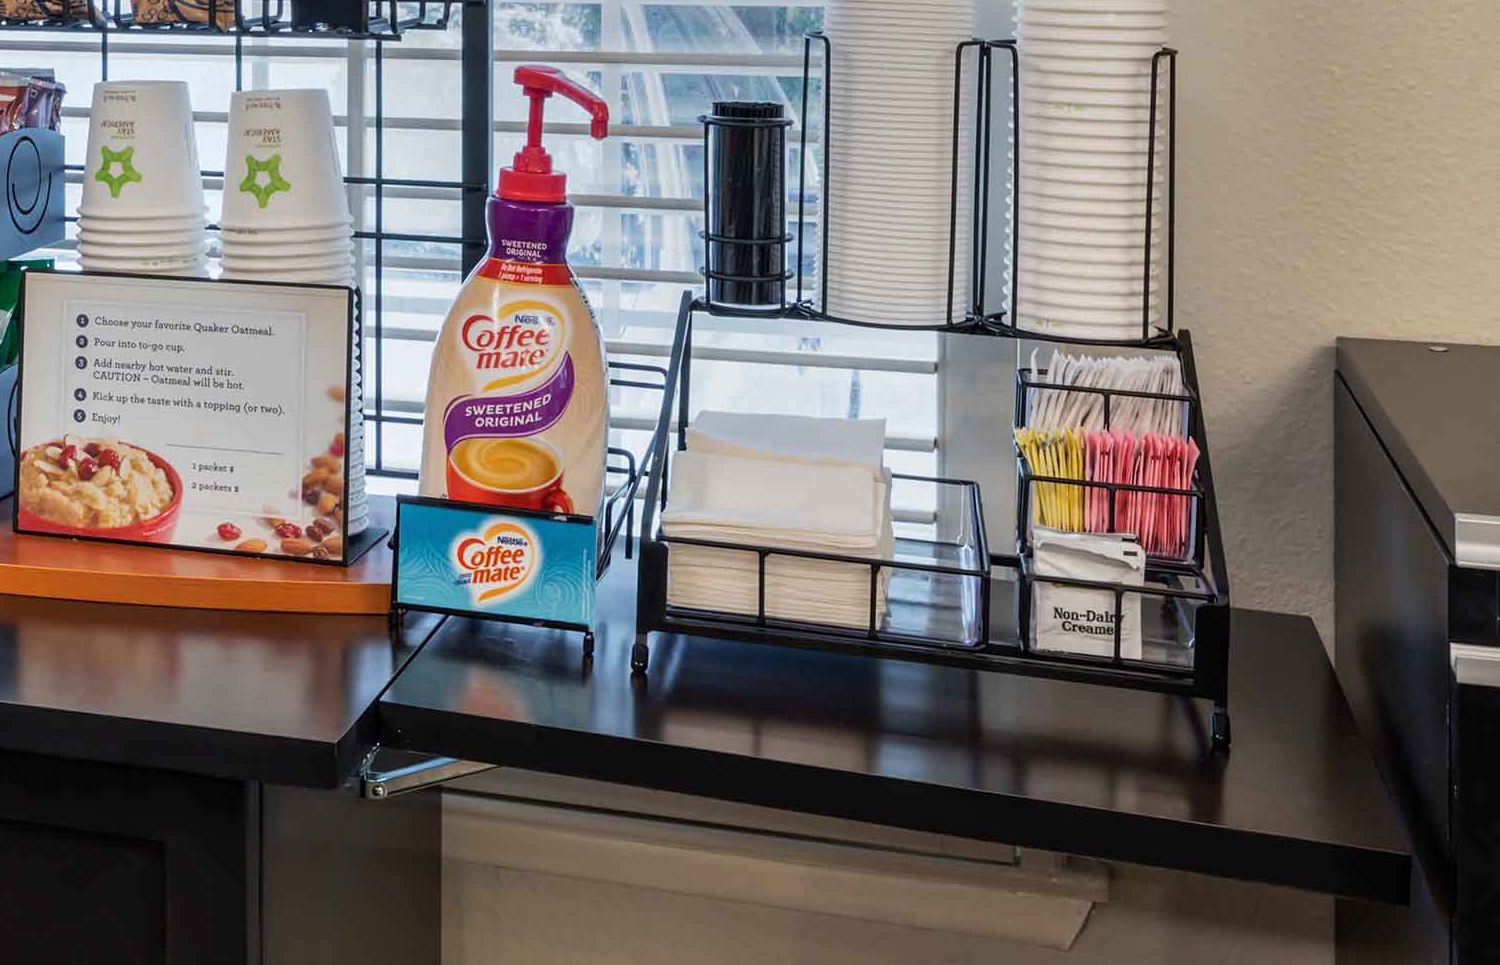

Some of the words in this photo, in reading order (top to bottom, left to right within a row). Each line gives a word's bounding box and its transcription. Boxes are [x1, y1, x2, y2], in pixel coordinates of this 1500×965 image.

[501, 239, 548, 251] SWEETENED
[506, 247, 541, 258] ORIGINAL
[94, 316, 129, 327] Choose
[131, 320, 152, 330] your
[155, 319, 191, 331] favorite
[193, 322, 229, 333] Quaker
[231, 324, 275, 337] Oatmeal.
[461, 314, 550, 352] Coffee
[93, 337, 116, 348] Pour
[118, 339, 137, 349] into
[138, 341, 164, 352] to-go
[165, 343, 185, 354] cup.
[93, 357, 112, 368] Add
[114, 359, 147, 372] nearby
[149, 361, 164, 372] hot
[166, 365, 193, 374] water
[195, 365, 213, 375] and
[215, 367, 235, 377] stir.
[476, 348, 546, 370] mate
[93, 371, 141, 382] CAUTION
[151, 374, 190, 386] Oatmeal
[193, 377, 211, 388] will
[213, 378, 224, 388] be
[227, 379, 244, 390] hot.
[92, 391, 114, 402] Kick
[116, 395, 128, 404] up
[130, 393, 145, 404] the
[147, 396, 171, 406] taste
[173, 397, 194, 408] with
[204, 401, 240, 413] topping
[243, 401, 258, 415] (or
[260, 403, 284, 416] two).
[465, 394, 552, 417] SWEETENED
[91, 412, 121, 425] Enjoy!
[475, 412, 542, 428] ORIGINAL
[199, 461, 228, 473] packet
[199, 481, 231, 493] packets
[457, 538, 524, 570] Coffee
[473, 566, 520, 584] mate
[1062, 620, 1115, 636] Creame
